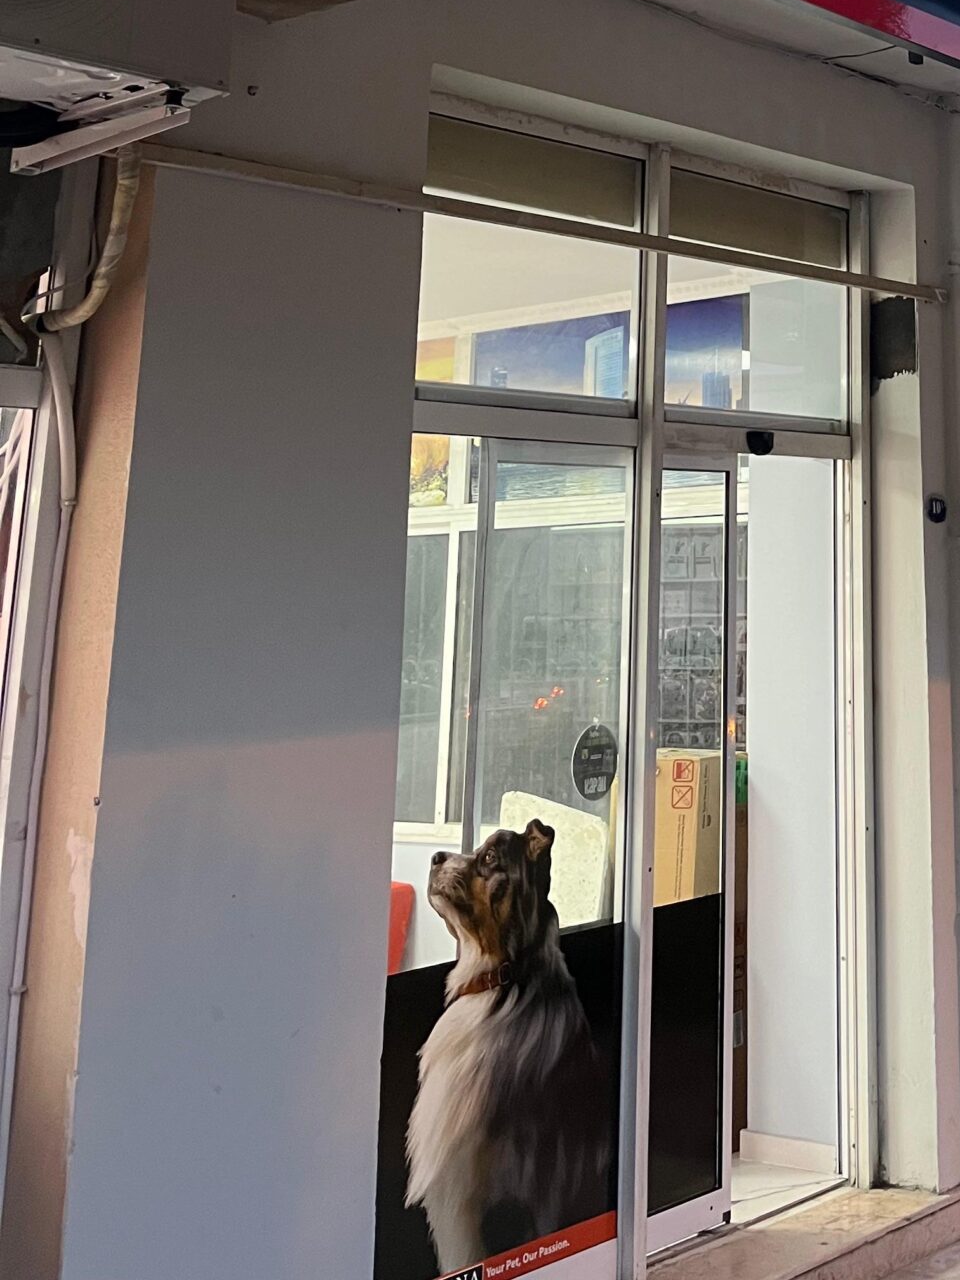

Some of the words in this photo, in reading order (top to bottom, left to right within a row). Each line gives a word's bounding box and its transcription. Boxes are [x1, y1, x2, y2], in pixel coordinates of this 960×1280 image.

[486, 1263, 505, 1278] Your
[505, 1257, 521, 1271] Pet,
[522, 1250, 538, 1264] Our
[539, 1239, 571, 1258] Passion.
